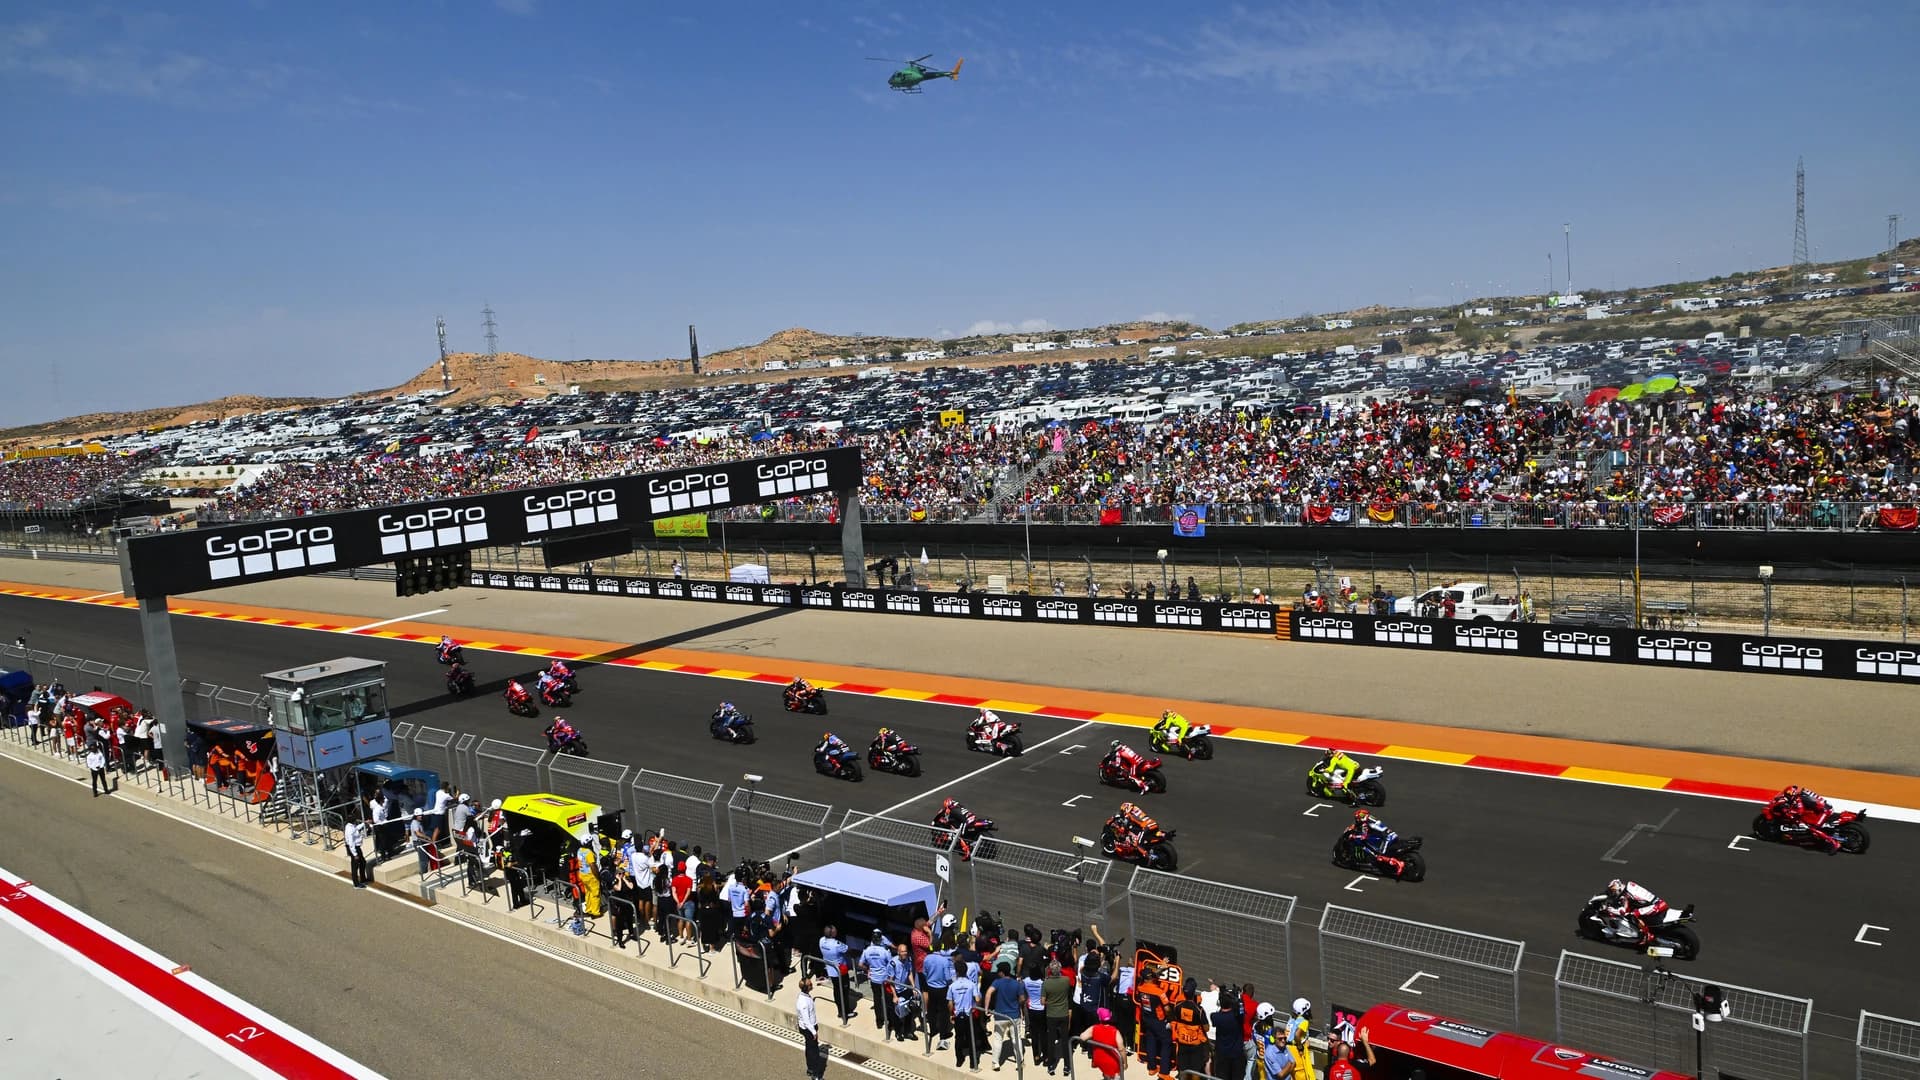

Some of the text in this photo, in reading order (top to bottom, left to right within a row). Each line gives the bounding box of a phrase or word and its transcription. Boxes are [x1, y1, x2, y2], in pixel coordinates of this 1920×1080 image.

[757, 459, 827, 480] GoPro
[649, 474, 729, 495] GoPro
[524, 488, 616, 513] GoPro
[378, 506, 486, 533] GoPro
[206, 526, 333, 556] GoPro
[567, 577, 589, 585] GoPro
[626, 580, 650, 588] GoPro
[657, 581, 682, 590] GoPro
[690, 583, 716, 592] GoPro
[725, 586, 753, 594] GoPro
[762, 588, 790, 596] GoPro
[801, 590, 831, 598] GoPro
[842, 592, 874, 600] GoPro
[886, 594, 920, 603] GoPro
[932, 596, 969, 605] GoPro
[983, 598, 1021, 608] GoPro
[1036, 601, 1078, 610] GoPro
[1093, 603, 1137, 613] GoPro
[1154, 605, 1201, 615] GoPro
[1220, 608, 1271, 618] GoPro
[1299, 617, 1352, 629] GoPro
[1375, 621, 1431, 633] GoPro
[1456, 626, 1517, 639] GoPro
[1544, 631, 1610, 644] GoPro
[1638, 636, 1711, 650] GoPro
[1743, 642, 1822, 658] GoPro
[1440, 1020, 1488, 1035] Lenovo
[225, 1026, 265, 1042] 12
[1592, 1058, 1647, 1075] Lenovo
